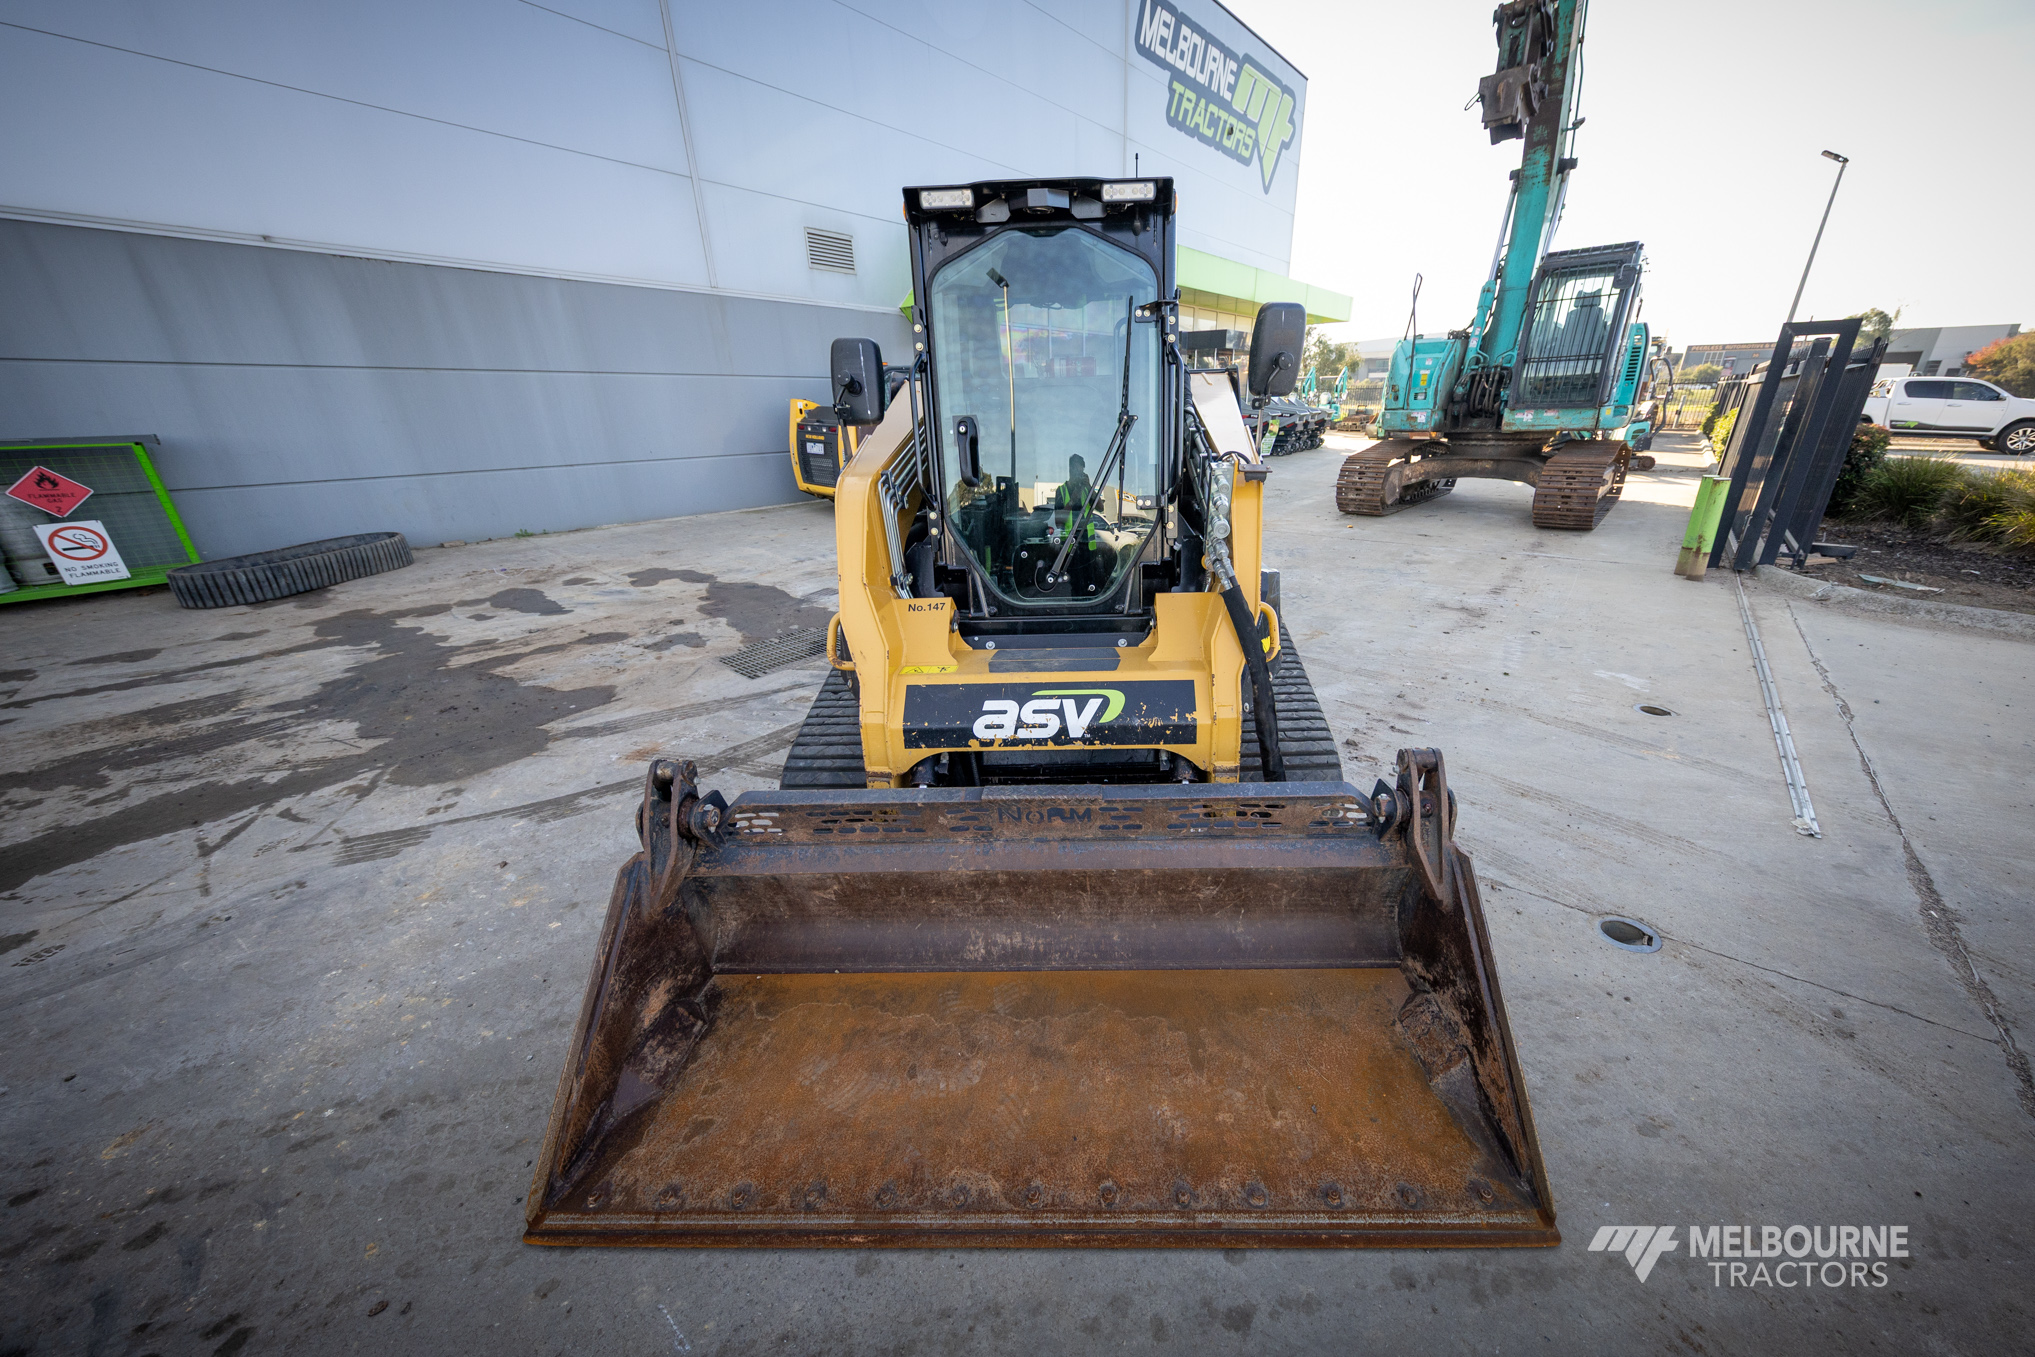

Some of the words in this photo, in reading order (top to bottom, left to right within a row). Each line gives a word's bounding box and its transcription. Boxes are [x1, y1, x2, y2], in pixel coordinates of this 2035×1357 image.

[1139, 0, 1238, 102] MELBOURNE
[1170, 80, 1256, 159] TRACTORS
[80, 562, 119, 571] SMOKING
[69, 568, 121, 578] FLAMMABLE
[908, 602, 946, 612] No.147
